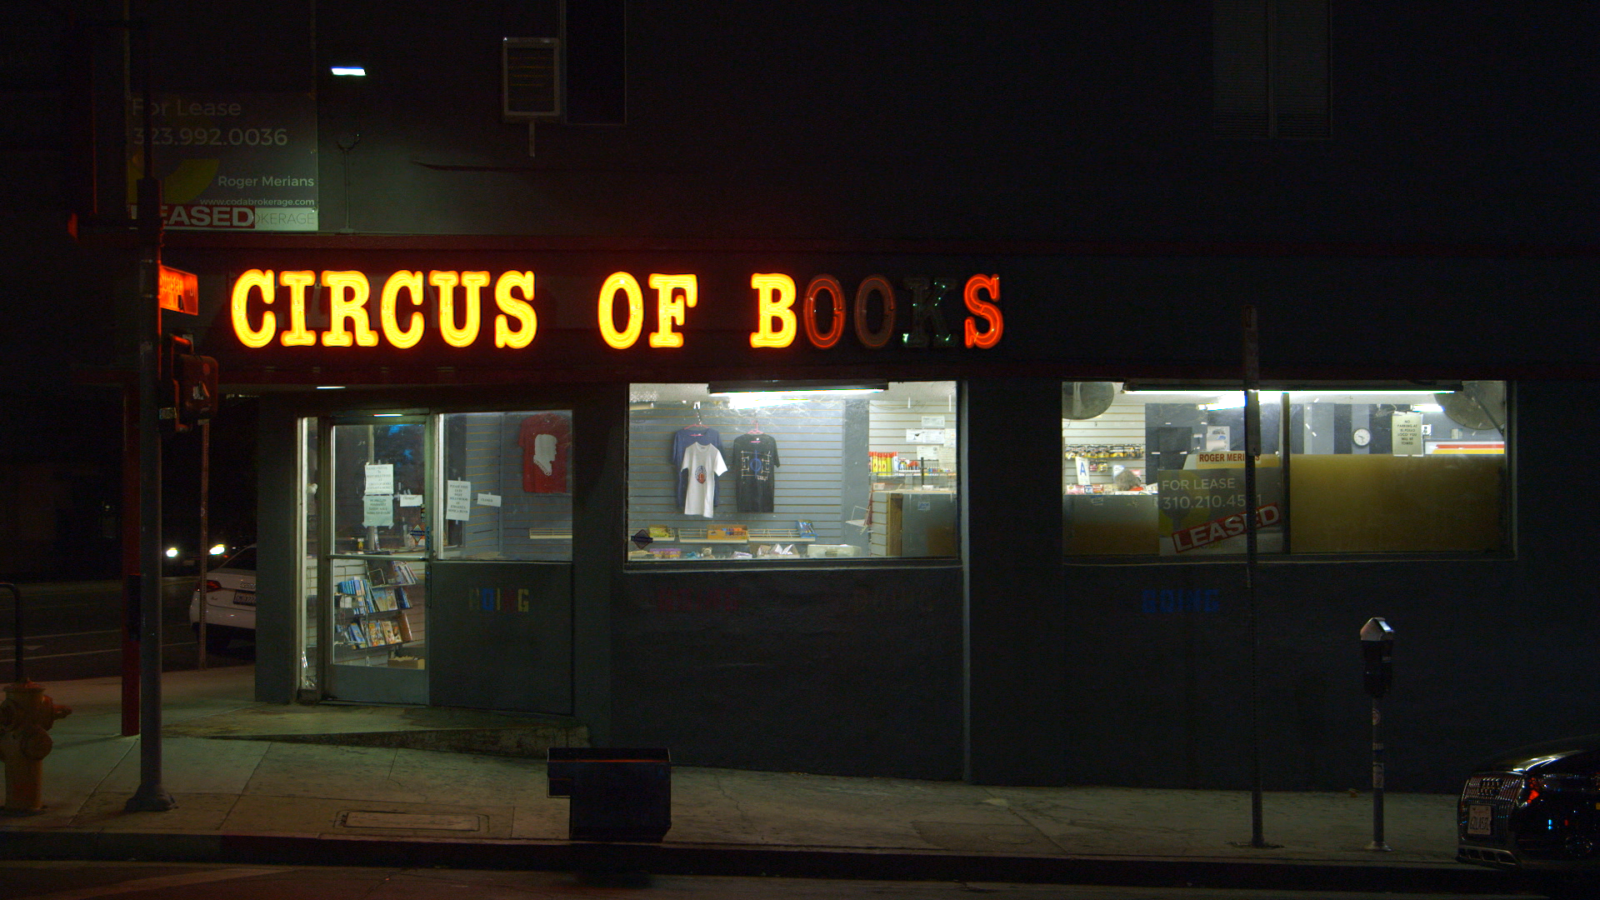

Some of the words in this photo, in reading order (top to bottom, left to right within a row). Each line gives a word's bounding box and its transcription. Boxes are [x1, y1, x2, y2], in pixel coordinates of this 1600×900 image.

[177, 99, 242, 117] Lease
[133, 128, 288, 146] 323.992.0036
[217, 176, 258, 189] Roger
[262, 176, 315, 187] Merians
[199, 198, 315, 207] www.codabrokerage.com
[231, 269, 538, 349] CIRCUS
[597, 270, 698, 349] OF
[750, 272, 1004, 349] BOOKS
[1199, 453, 1225, 463] ROGER
[1227, 453, 1260, 462] MERIS
[1079, 462, 1087, 476] A
[1162, 479, 1189, 490] FOR
[1193, 478, 1236, 490] LEASE
[1162, 494, 1262, 510] 310.210.451
